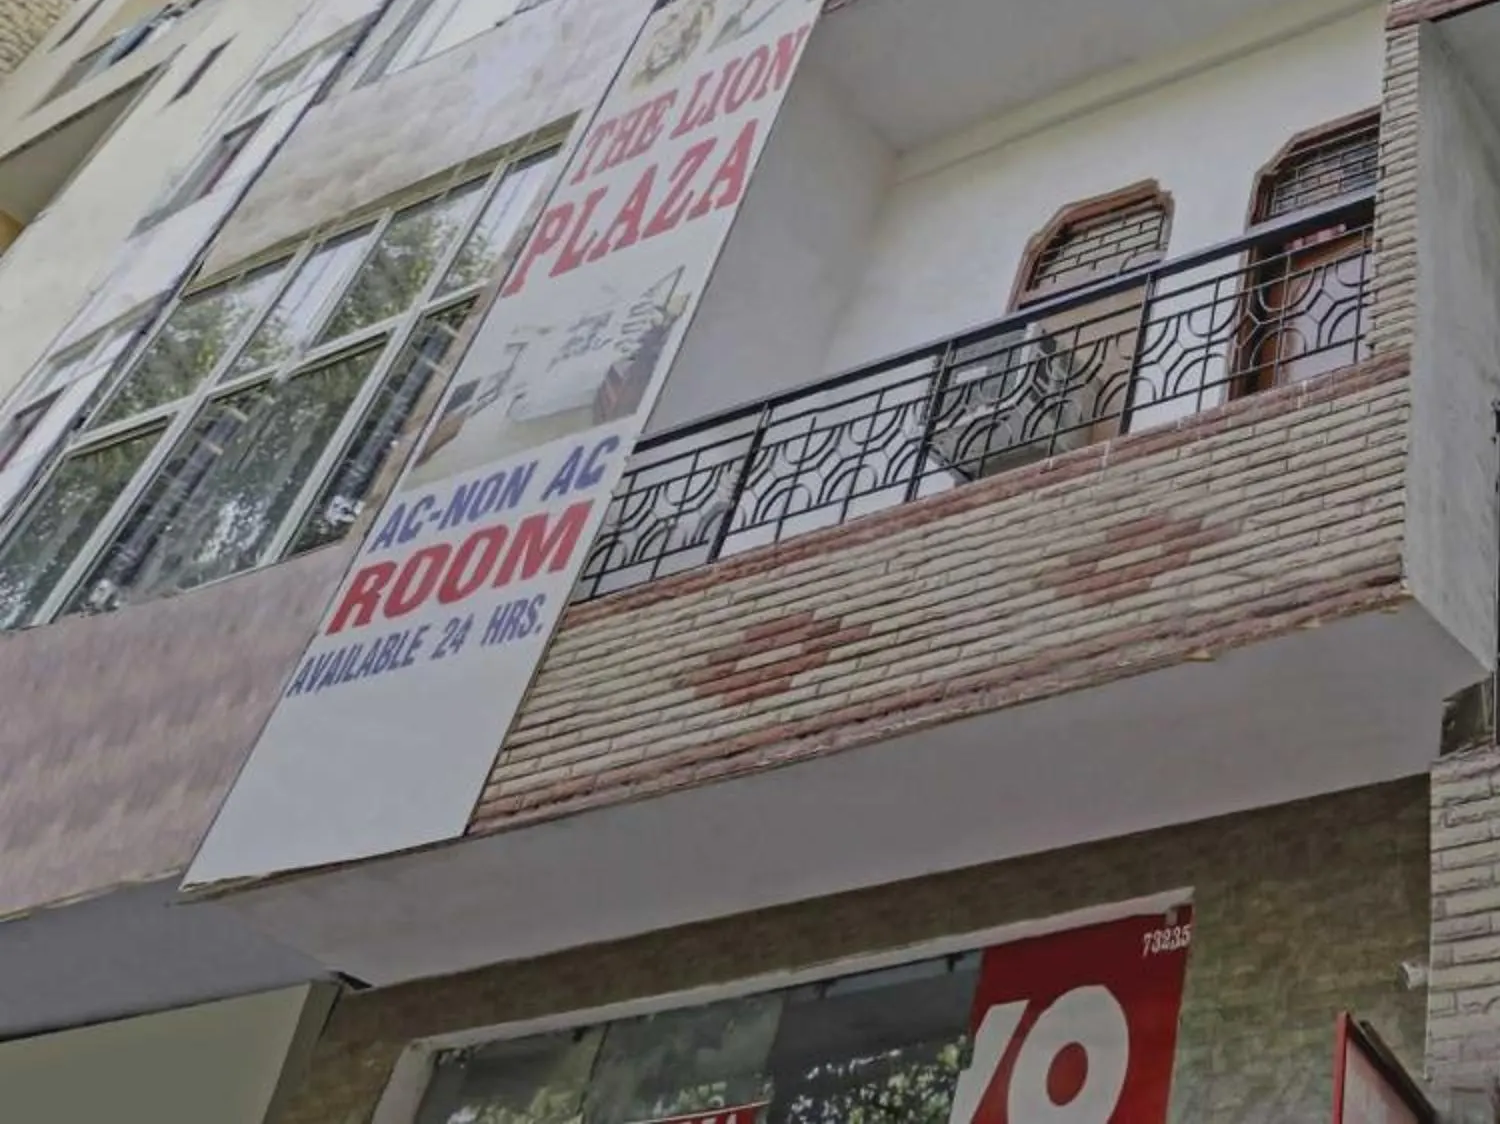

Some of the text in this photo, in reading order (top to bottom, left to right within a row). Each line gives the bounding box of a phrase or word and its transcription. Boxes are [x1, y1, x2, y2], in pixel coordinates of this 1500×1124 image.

[571, 22, 812, 186] THE LION
[501, 118, 759, 298] PLAZA
[366, 435, 620, 555] AC-NON AC
[324, 498, 595, 636] ROOM
[285, 594, 547, 698] AVAILABLE 24 HRS.
